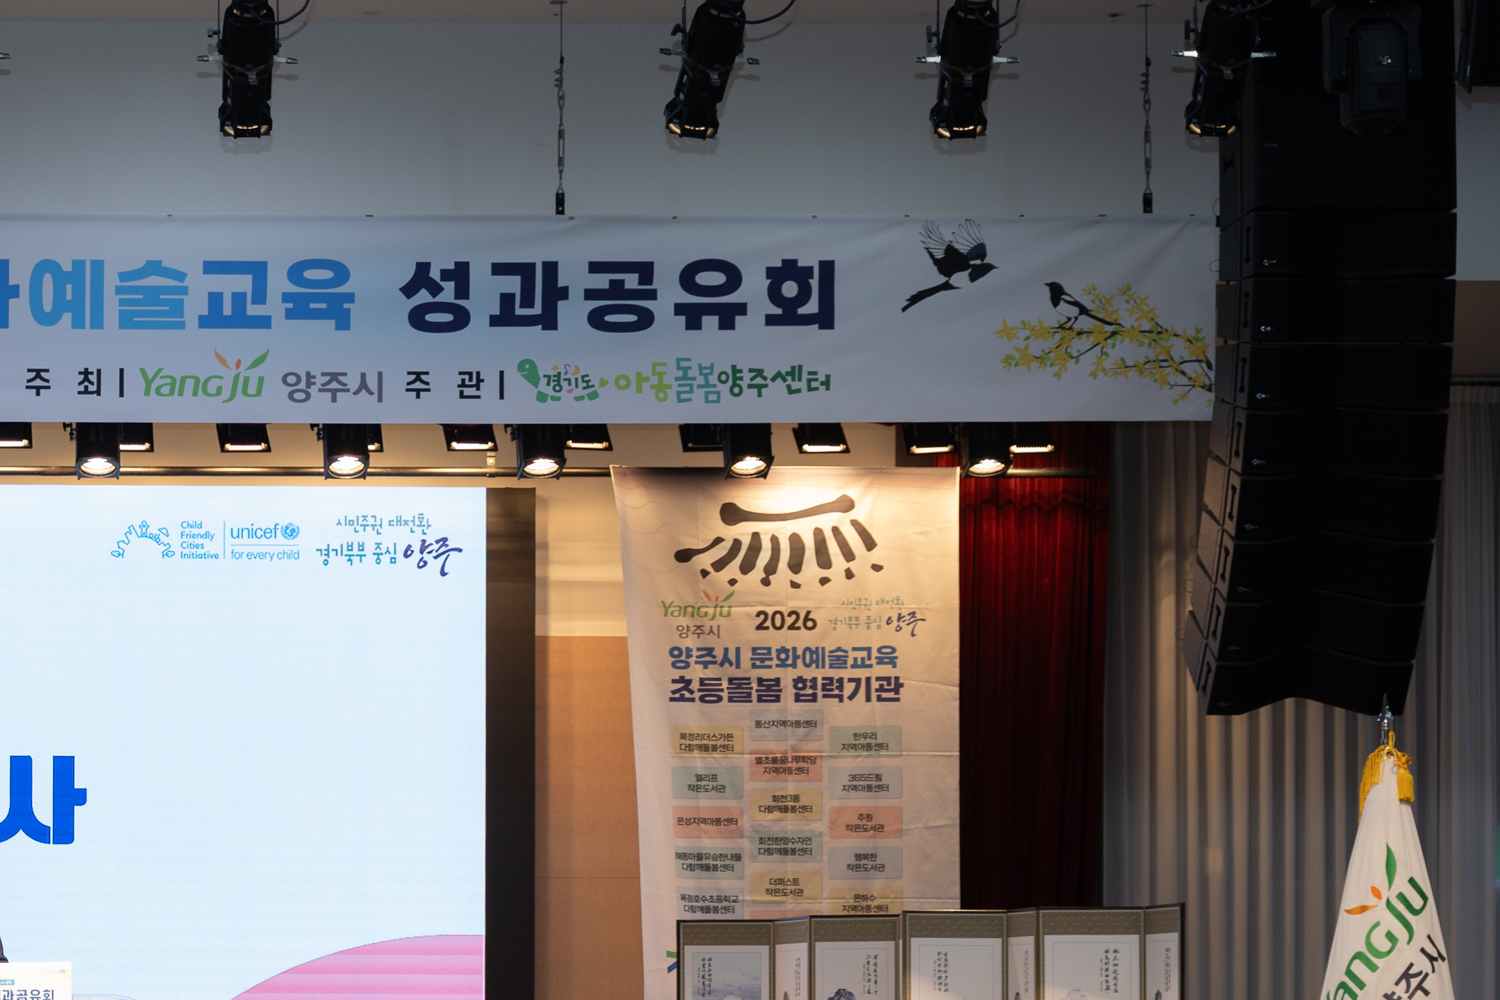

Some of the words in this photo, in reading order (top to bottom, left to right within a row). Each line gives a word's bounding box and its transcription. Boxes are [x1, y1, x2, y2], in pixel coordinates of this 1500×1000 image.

[399, 259, 835, 333] 성과공유회
[26, 369, 51, 396] 주
[78, 368, 101, 396] 최
[282, 371, 383, 403] 양주시
[406, 371, 431, 399] 주
[457, 371, 484, 399] 관
[542, 368, 597, 394] 경기도
[614, 358, 831, 403] 아동돌봄양주센터
[180, 520, 203, 530] Child
[335, 514, 383, 534] 시민주권
[389, 513, 431, 534] 대전환
[180, 530, 216, 542] Friendly
[230, 522, 280, 540] unicef
[180, 540, 205, 550] Cities
[180, 550, 220, 560] Initiative
[230, 548, 244, 561] for
[245, 551, 274, 562] every
[276, 549, 301, 561] child
[316, 542, 366, 566] 경기북부
[373, 543, 396, 565] 중심
[403, 537, 462, 577] 양주
[755, 610, 817, 630] 2026
[827, 615, 861, 632] 경기북부
[864, 615, 882, 631] 중심
[886, 611, 926, 637] 양주
[675, 624, 721, 640] 양주시
[669, 646, 741, 670] 양주시
[750, 646, 898, 669] 문화예술교육
[669, 676, 782, 704] 초등돌봄
[792, 676, 904, 703] 협력기관
[754, 719, 818, 729] 동산지역아동센터
[679, 732, 735, 743] 옥정리더스가든
[852, 731, 878, 742] 한우리
[679, 742, 735, 753] 다함께돌봄센터
[840, 742, 889, 752] 지역아동센터
[762, 766, 810, 776] 지역아동센터
[847, 773, 883, 783] 365드림
[687, 783, 727, 794] 작은도서관
[841, 783, 890, 794] 지역아동센터
[758, 804, 813, 814] 다함께돌봄센터
[676, 816, 739, 827] 은성지역아동센터
[845, 823, 886, 833] 작은도서관
[757, 846, 813, 857] 다함께돌봄센터
[853, 852, 878, 862] 행복한
[681, 862, 735, 873] 다함께돌봄센터
[846, 863, 886, 873] 작은도서관
[765, 887, 805, 898] 작은도서관
[852, 893, 877, 904] 은하수
[683, 904, 736, 915] 다함께돌봄센터
[841, 904, 890, 915] 지역아동센터
